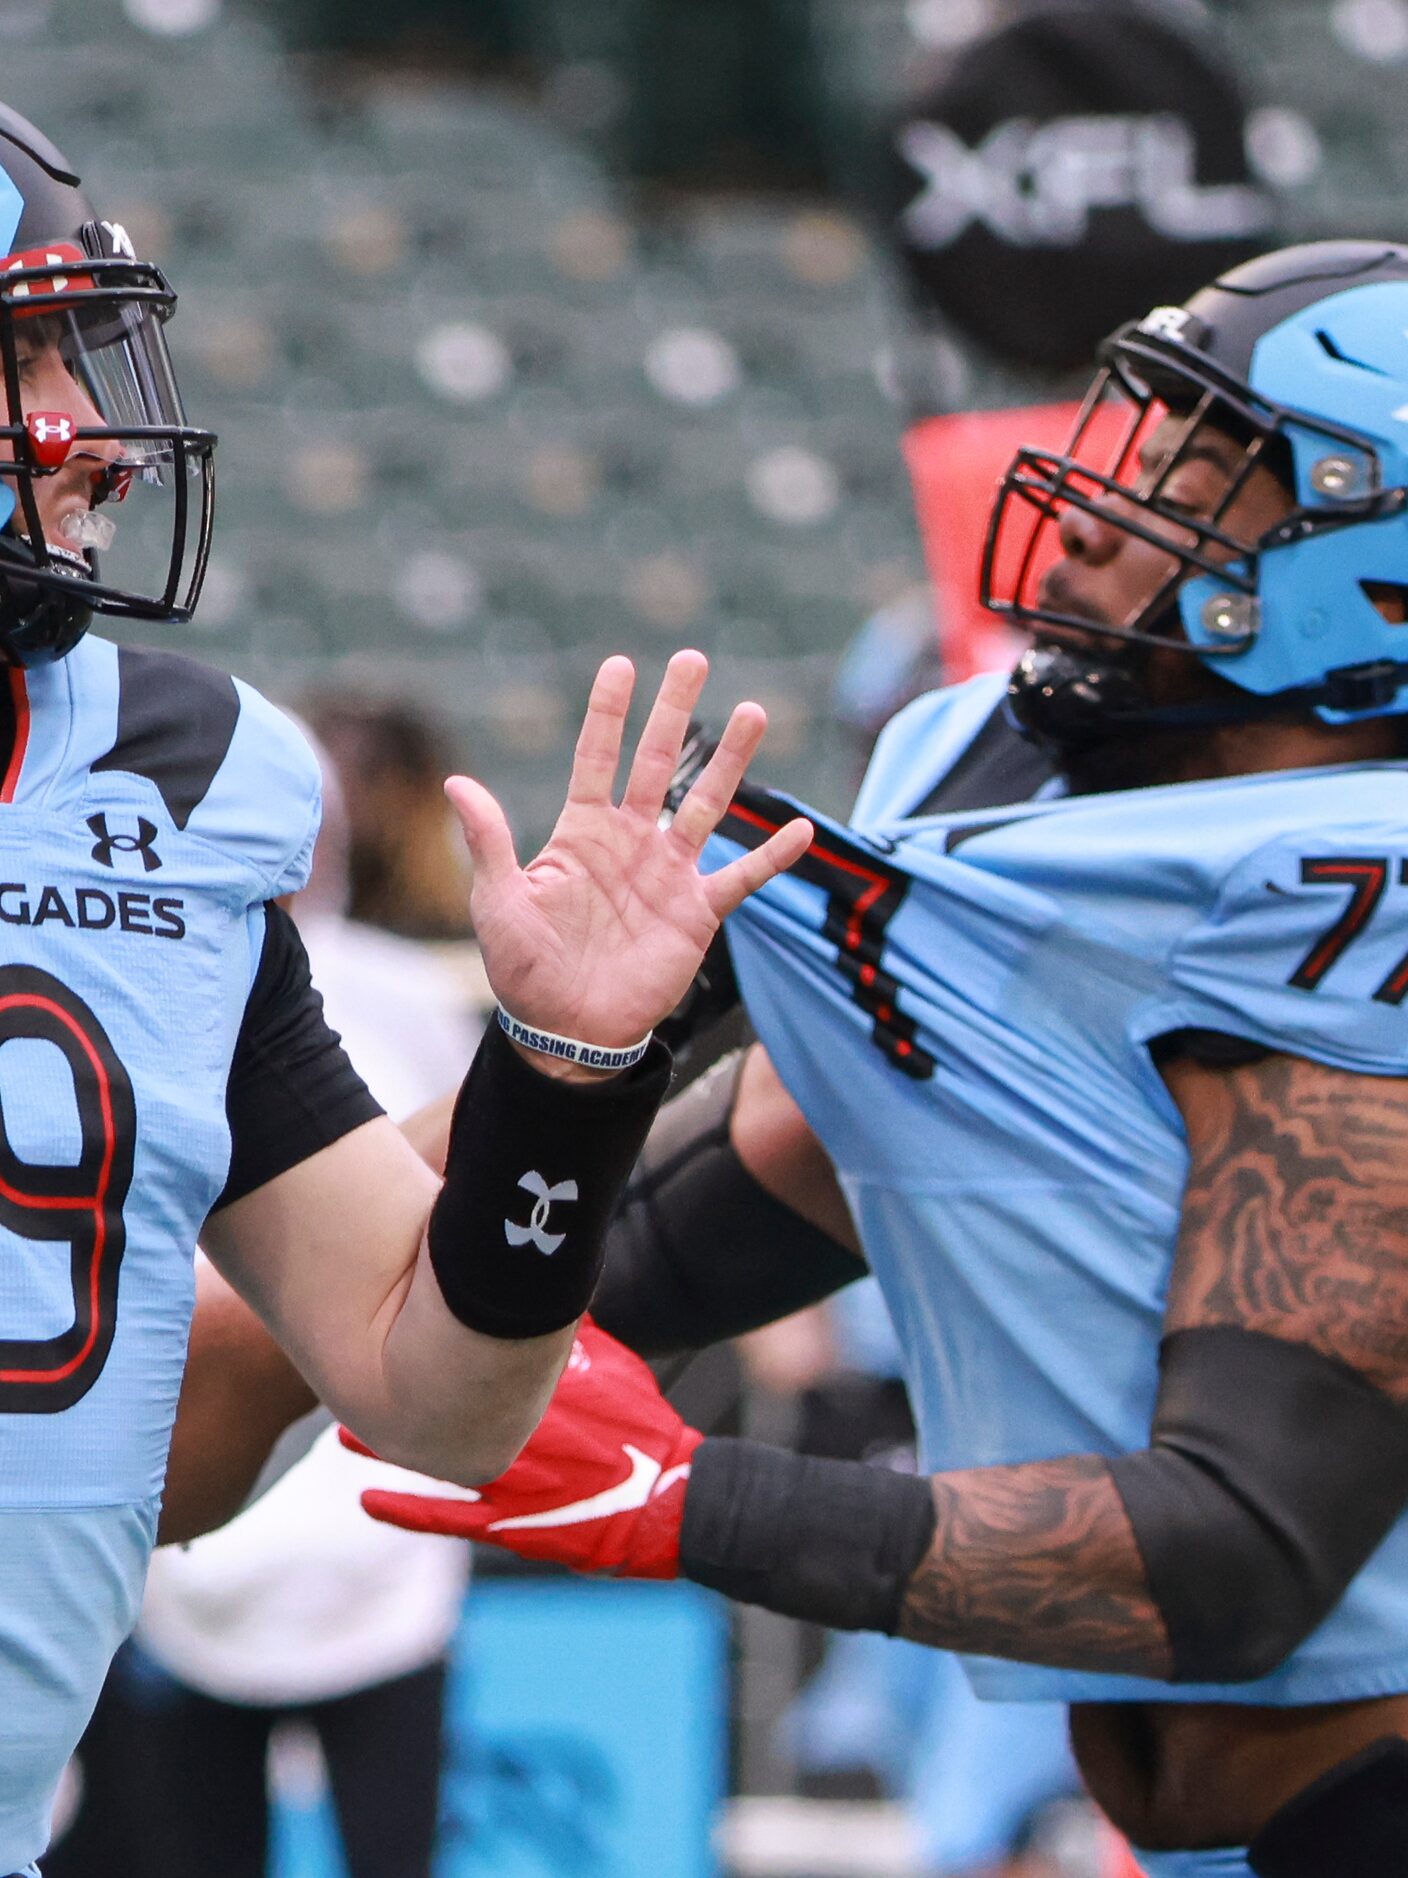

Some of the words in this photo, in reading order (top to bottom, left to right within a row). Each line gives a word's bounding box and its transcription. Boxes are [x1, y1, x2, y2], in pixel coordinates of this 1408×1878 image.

[896, 115, 1274, 250] XFL
[512, 1023, 577, 1059] PASSING
[579, 1043, 647, 1067] ACADEMY
